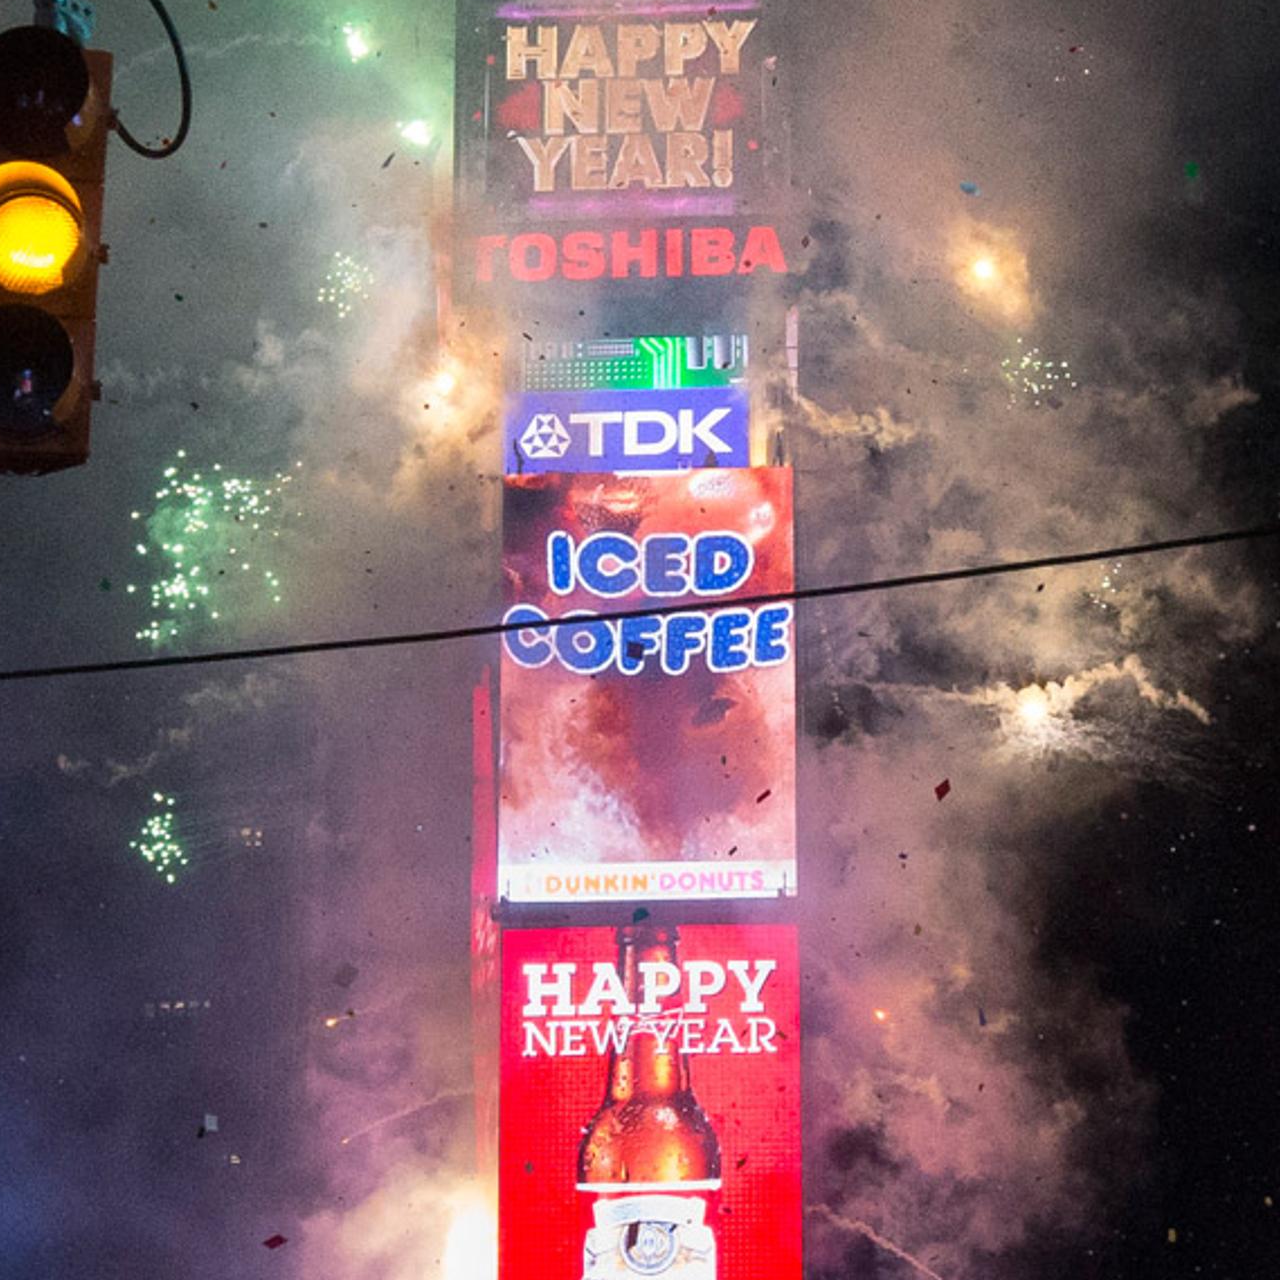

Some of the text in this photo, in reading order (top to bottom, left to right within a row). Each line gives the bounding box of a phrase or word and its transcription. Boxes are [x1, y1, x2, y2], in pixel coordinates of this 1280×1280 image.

[505, 20, 757, 79] HAPPY
[543, 78, 715, 135] NEW
[519, 131, 733, 191] YEAR!
[474, 226, 787, 280] TOSHIBA
[570, 408, 732, 458] TDK
[547, 531, 754, 596] ICED
[502, 604, 792, 675] COFFEE
[545, 869, 764, 894] DUNKIN' DONUTS
[521, 960, 776, 1017] HAPPY
[522, 1019, 777, 1057] NEW YEAR
